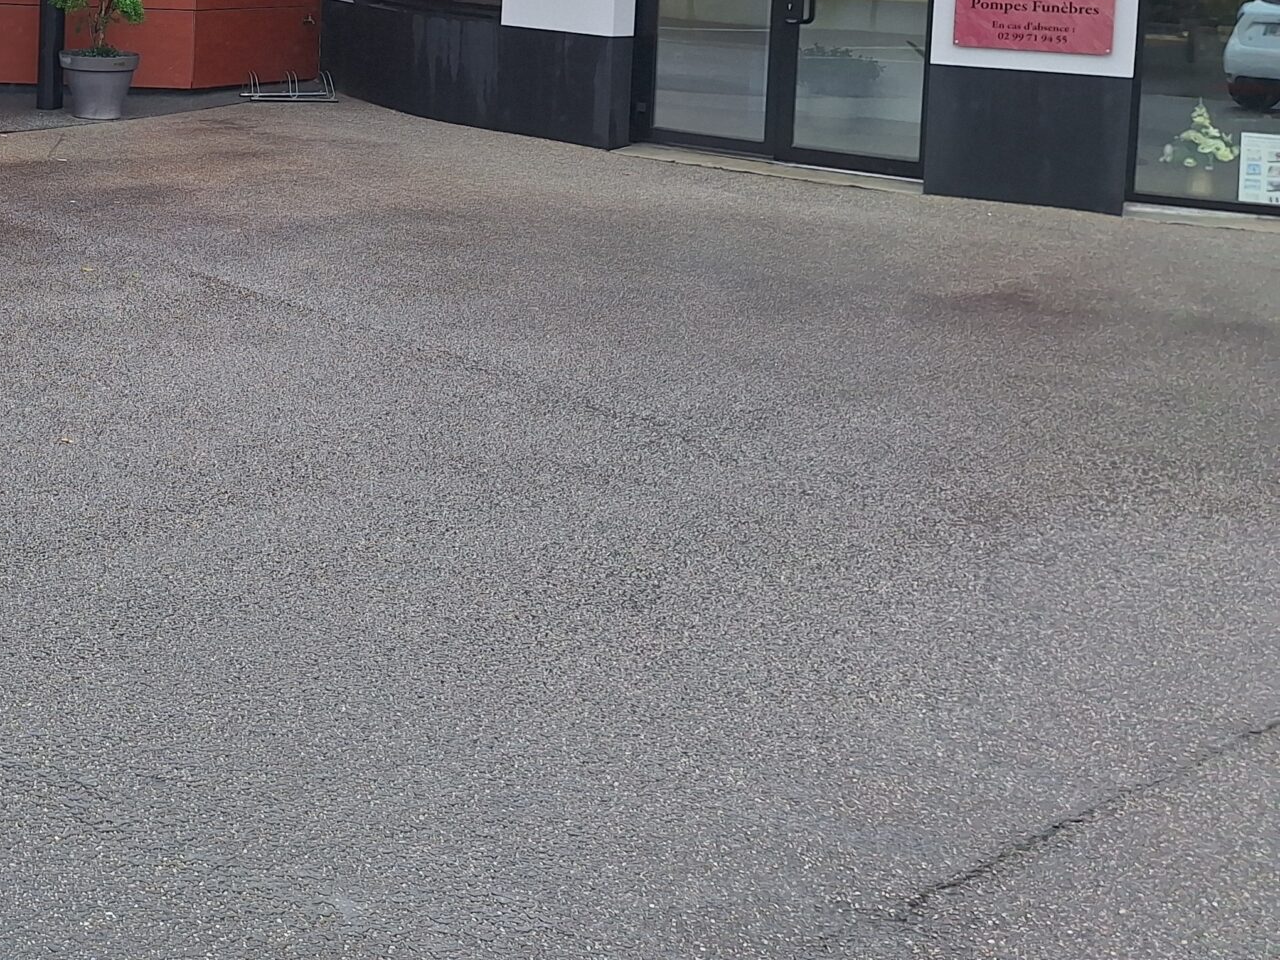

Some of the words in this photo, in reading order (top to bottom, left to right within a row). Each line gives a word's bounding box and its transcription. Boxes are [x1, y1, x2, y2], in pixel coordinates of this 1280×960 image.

[1032, 0, 1100, 15] Funèbres
[991, 20, 1005, 29] En
[1007, 23, 1021, 31] cas
[1023, 22, 1070, 33] d'absence
[997, 32, 1010, 41] 02
[1012, 33, 1025, 42] 99
[1027, 34, 1038, 43] 71
[1056, 36, 1068, 45] 55
